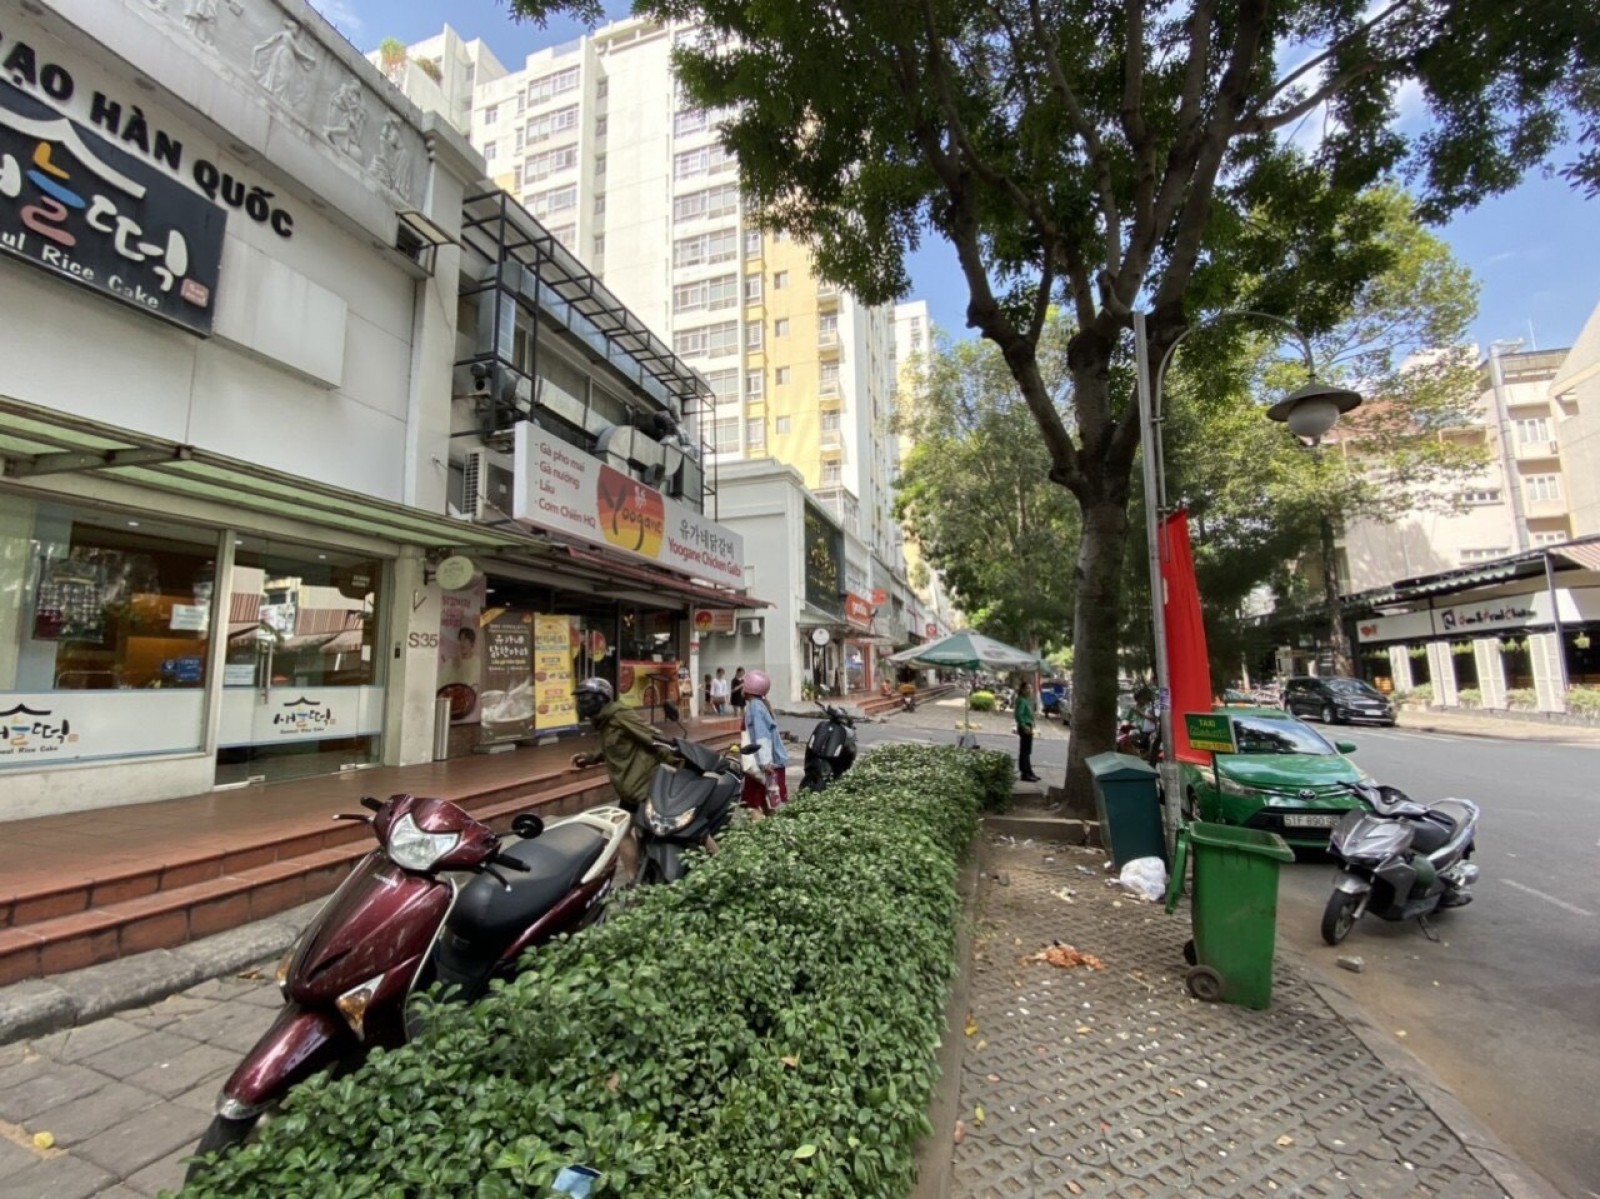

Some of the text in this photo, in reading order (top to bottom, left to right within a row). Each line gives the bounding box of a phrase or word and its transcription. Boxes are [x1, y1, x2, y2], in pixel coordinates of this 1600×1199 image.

[0, 30, 294, 239] ẠO HÀN QUỐC
[41, 244, 95, 281] Rice
[108, 274, 159, 309] Cake
[668, 536, 701, 562] Yoogane
[679, 519, 735, 559] 유가네닭갈비
[408, 632, 439, 648] S35
[1199, 719, 1216, 727] TAXI
